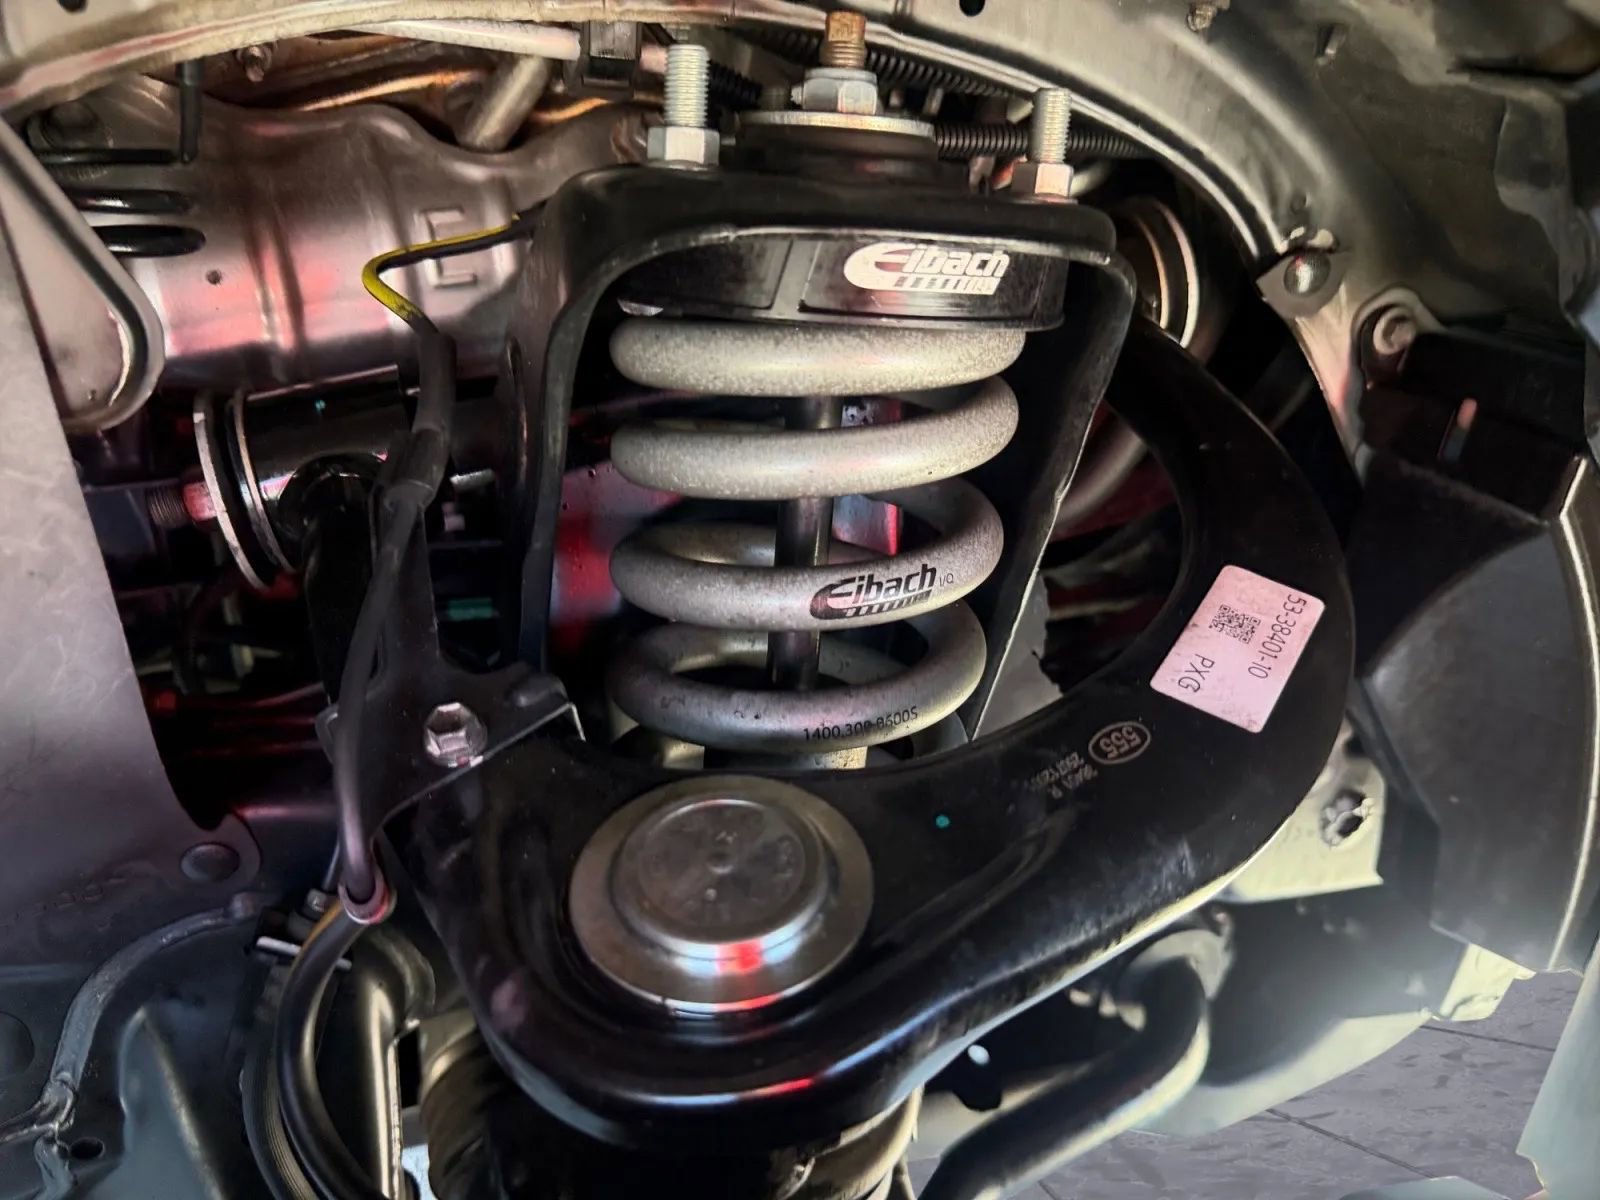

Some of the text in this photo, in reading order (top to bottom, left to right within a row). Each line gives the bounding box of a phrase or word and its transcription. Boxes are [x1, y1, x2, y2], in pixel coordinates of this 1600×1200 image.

[843, 242, 1010, 295] Eibach
[809, 564, 937, 620] Eibach
[1248, 594, 1307, 680] 53-38401-10
[1178, 653, 1216, 693] PXG
[1099, 726, 1141, 759] 555
